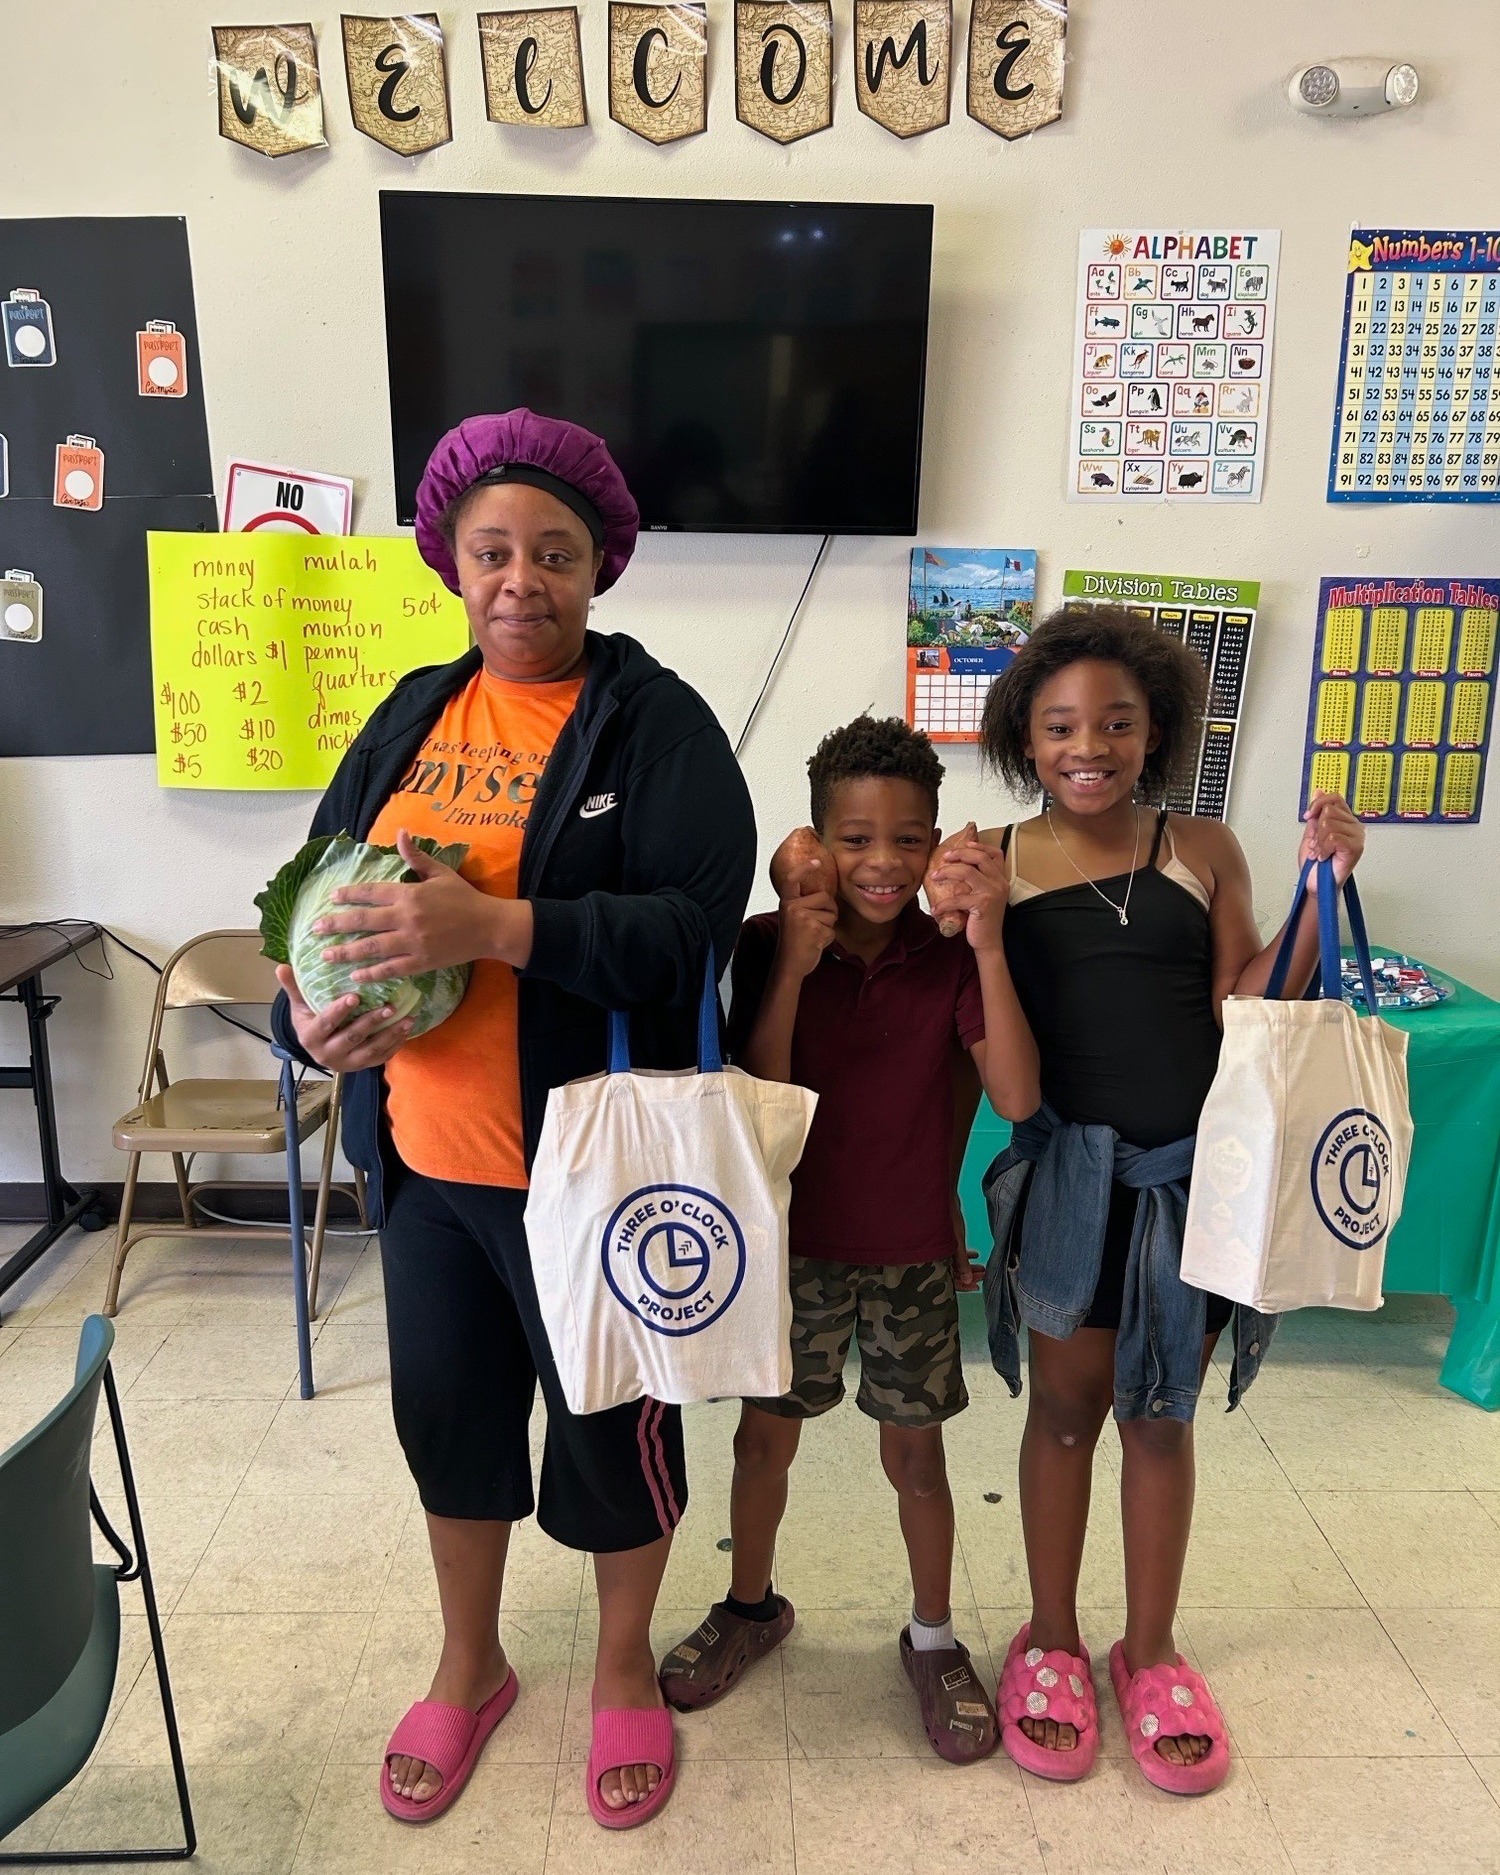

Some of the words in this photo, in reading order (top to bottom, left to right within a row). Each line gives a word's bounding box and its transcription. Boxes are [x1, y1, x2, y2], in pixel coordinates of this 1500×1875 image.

[1133, 236, 1258, 259] ALPHABET
[1373, 235, 1464, 263] Numbers
[1091, 267, 1104, 276] Aa
[1129, 268, 1141, 276] Bb
[1165, 268, 1178, 277] Cc
[1202, 268, 1215, 277] Dd
[1240, 268, 1251, 277] Ee
[1362, 278, 1367, 290] 1
[1379, 277, 1387, 290] 2
[1398, 277, 1406, 290] 3
[1415, 278, 1423, 290] 4
[1433, 278, 1441, 291] 5
[1450, 279, 1459, 291] 6
[1469, 279, 1478, 291] 7
[1488, 278, 1497, 291] 8
[1089, 307, 1099, 316] Ff
[1136, 307, 1147, 319] Gg
[1182, 307, 1194, 316] Hh
[1227, 307, 1236, 316] Ii
[1358, 300, 1367, 312] 11
[1376, 300, 1387, 312] 12
[1395, 300, 1405, 312] 13
[1412, 300, 1423, 313] 14
[1430, 301, 1440, 313] 15
[1447, 301, 1458, 313] 16
[1466, 301, 1478, 313] 17
[1485, 301, 1496, 313] 18
[1355, 322, 1367, 334] 21
[1372, 322, 1387, 334] 22
[1391, 322, 1405, 335] 23
[1408, 322, 1422, 335] 24
[1426, 323, 1439, 335] 25
[1443, 323, 1458, 335] 26
[1462, 323, 1477, 335] 27
[1481, 323, 1495, 335] 28
[1086, 347, 1097, 358] Jj
[1124, 346, 1135, 355] Kk
[1161, 347, 1168, 355] Ll
[1197, 347, 1216, 356] Mm
[1234, 347, 1247, 356] Nn
[1353, 344, 1364, 357] 31
[1370, 344, 1385, 356] 32
[1389, 344, 1402, 357] 33
[1406, 344, 1420, 357] 34
[1424, 345, 1437, 357] 35
[1441, 345, 1455, 358] 36
[1460, 345, 1474, 357] 37
[1478, 345, 1493, 357] 38
[1351, 366, 1363, 378] 41
[1369, 366, 1383, 378] 42
[1387, 366, 1400, 379] 43
[1404, 367, 1418, 379] 44
[1422, 367, 1435, 379] 45
[1439, 367, 1453, 379] 46
[1457, 367, 1472, 379] 47
[1476, 367, 1491, 379] 48
[1086, 386, 1098, 395] Oo
[1132, 386, 1144, 396] Pp
[1177, 386, 1191, 398] Qq
[1223, 386, 1235, 395] Rr
[1349, 388, 1360, 400] 51
[1366, 388, 1380, 400] 52
[1385, 388, 1398, 400] 53
[1401, 388, 1415, 400] 54
[1419, 389, 1432, 401] 55
[1436, 389, 1451, 401] 56
[1455, 389, 1470, 401] 57
[1473, 389, 1488, 401] 58
[1347, 410, 1359, 421] 61
[1364, 409, 1378, 422] 62
[1382, 409, 1396, 422] 63
[1399, 410, 1413, 422] 64
[1417, 410, 1430, 422] 65
[1433, 410, 1448, 422] 66
[1452, 410, 1467, 422] 67
[1471, 410, 1486, 422] 68
[1084, 424, 1095, 433] Ss
[1130, 425, 1140, 433] Tt
[1175, 425, 1187, 433] Uu
[1220, 425, 1232, 433] Vv
[1083, 463, 1102, 472] Ww
[1126, 463, 1140, 472] Xx
[1172, 463, 1183, 474] Yy
[1217, 463, 1228, 472] Zz
[276, 481, 304, 511] NO
[194, 559, 254, 590] money
[304, 549, 376, 572] mulah
[1083, 576, 1163, 597] Division
[1171, 581, 1238, 602] Tables
[1328, 580, 1444, 608] Multiplication
[1449, 583, 1499, 611] Tables
[198, 588, 255, 609] stack
[264, 588, 286, 608] of
[292, 597, 352, 623] money
[403, 592, 441, 617] 50¢
[198, 617, 249, 640] cash
[192, 641, 257, 668] dollars
[266, 640, 287, 670] $1
[303, 645, 359, 673] penny
[312, 664, 398, 710] quarters
[160, 682, 200, 719] $100
[232, 681, 268, 705] $2
[308, 703, 361, 729] dimes
[170, 722, 206, 747] $50
[239, 718, 275, 741] $10
[172, 753, 201, 778] $5
[247, 747, 283, 772] $20
[585, 792, 616, 810] NIKE
[443, 807, 476, 826] I'm
[1325, 1124, 1359, 1166] THREE
[617, 1202, 657, 1253] THREE
[660, 1200, 729, 1250] O'CLOCK
[1334, 1206, 1381, 1235] PROJECT
[637, 1290, 715, 1321] PROJECT
